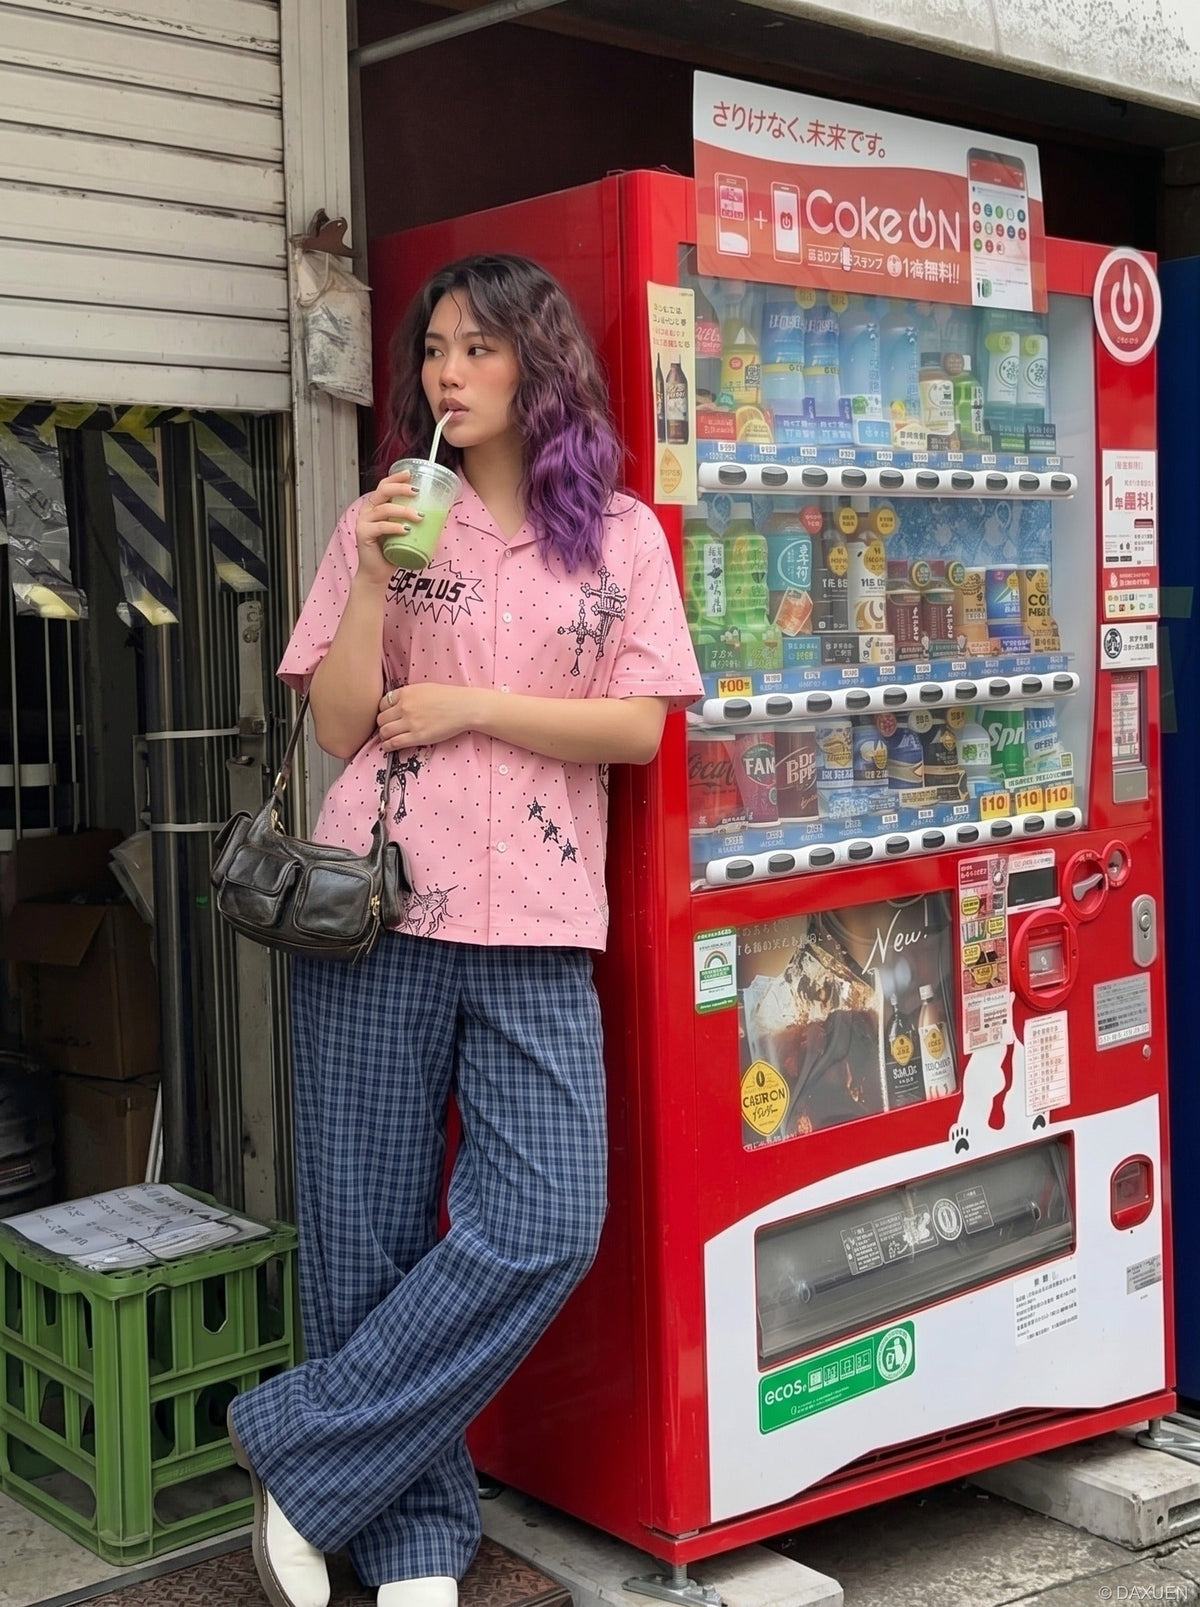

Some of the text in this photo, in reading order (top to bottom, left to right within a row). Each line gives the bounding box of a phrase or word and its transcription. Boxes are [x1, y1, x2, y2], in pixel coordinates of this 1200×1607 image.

[806, 189, 961, 253] Coke ON
[862, 898, 929, 976] New!
